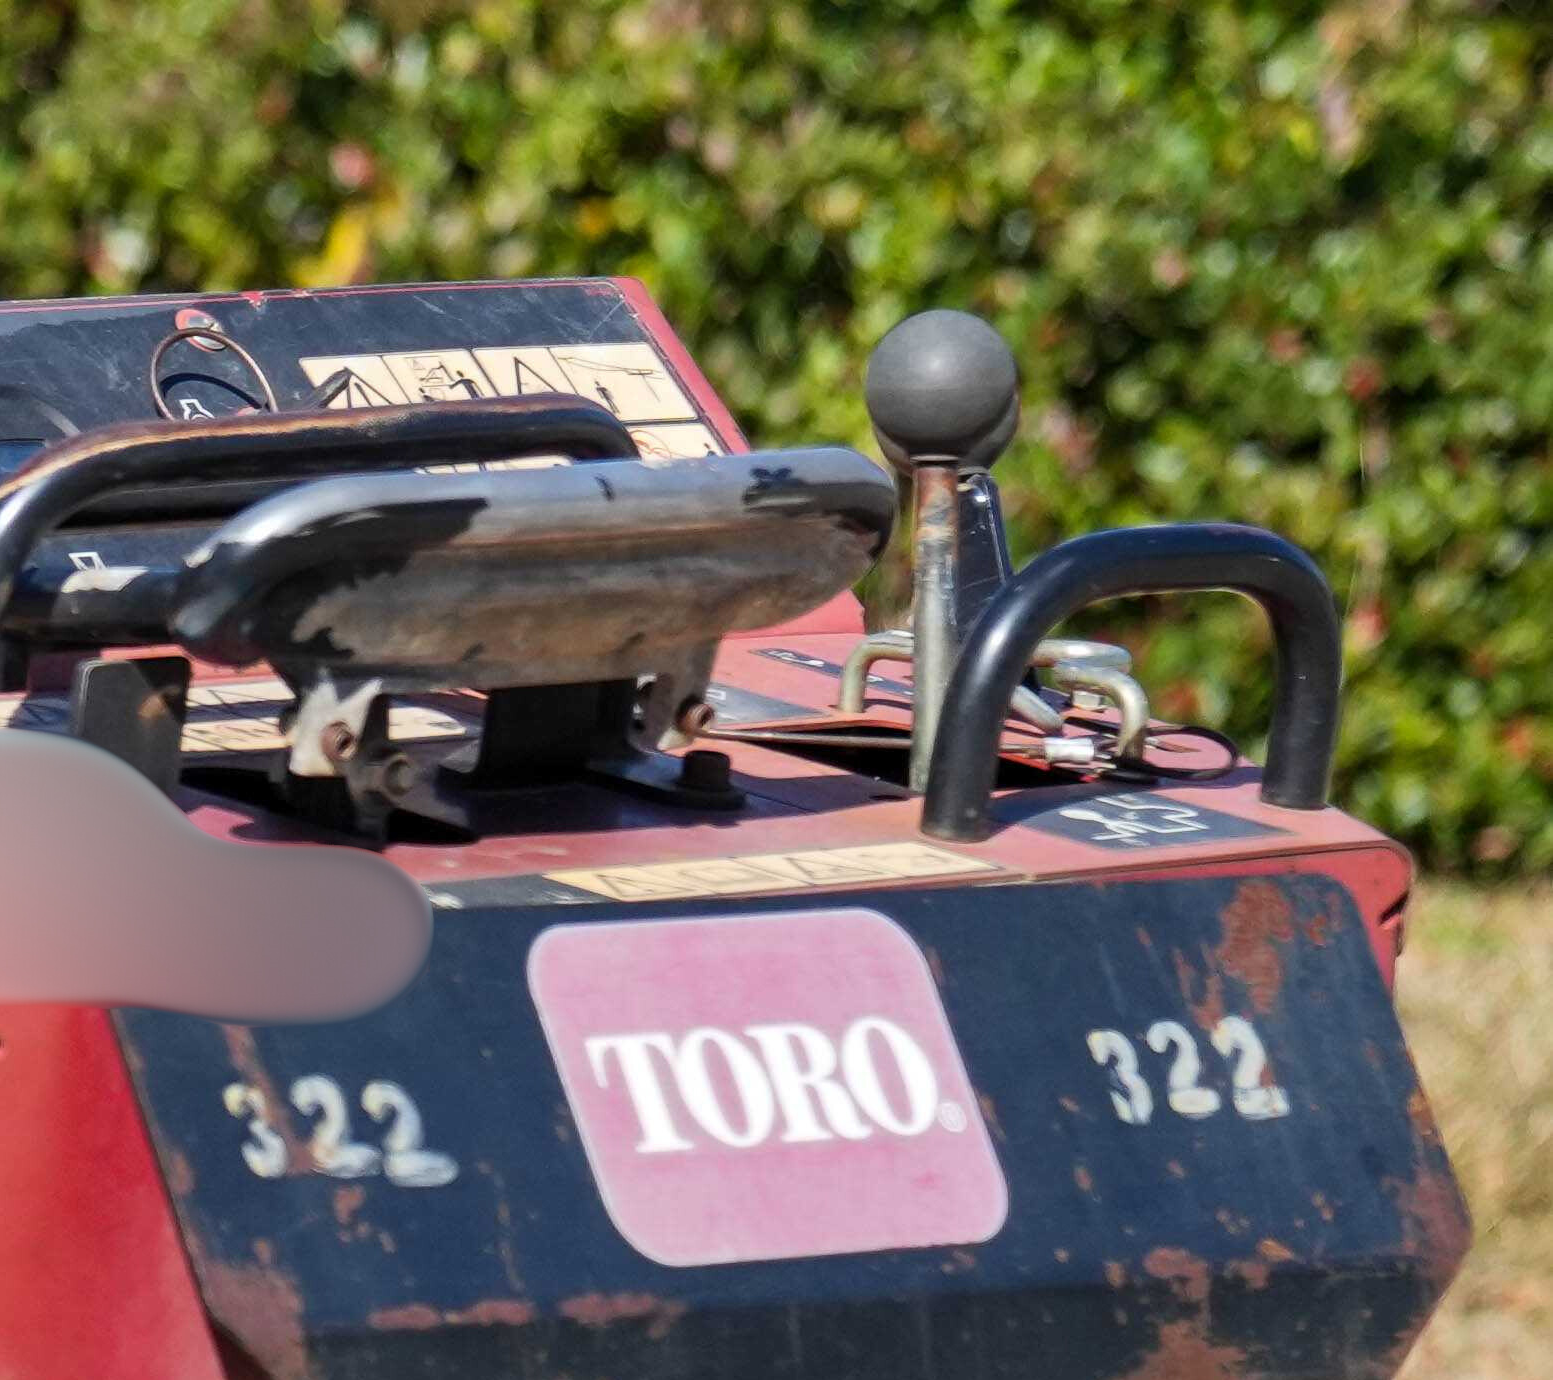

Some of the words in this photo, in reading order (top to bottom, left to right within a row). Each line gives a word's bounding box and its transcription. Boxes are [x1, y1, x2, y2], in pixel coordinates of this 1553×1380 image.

[585, 1016, 939, 1153] TORO
[1086, 1015, 1291, 1125] 322
[222, 1073, 459, 1187] 322
